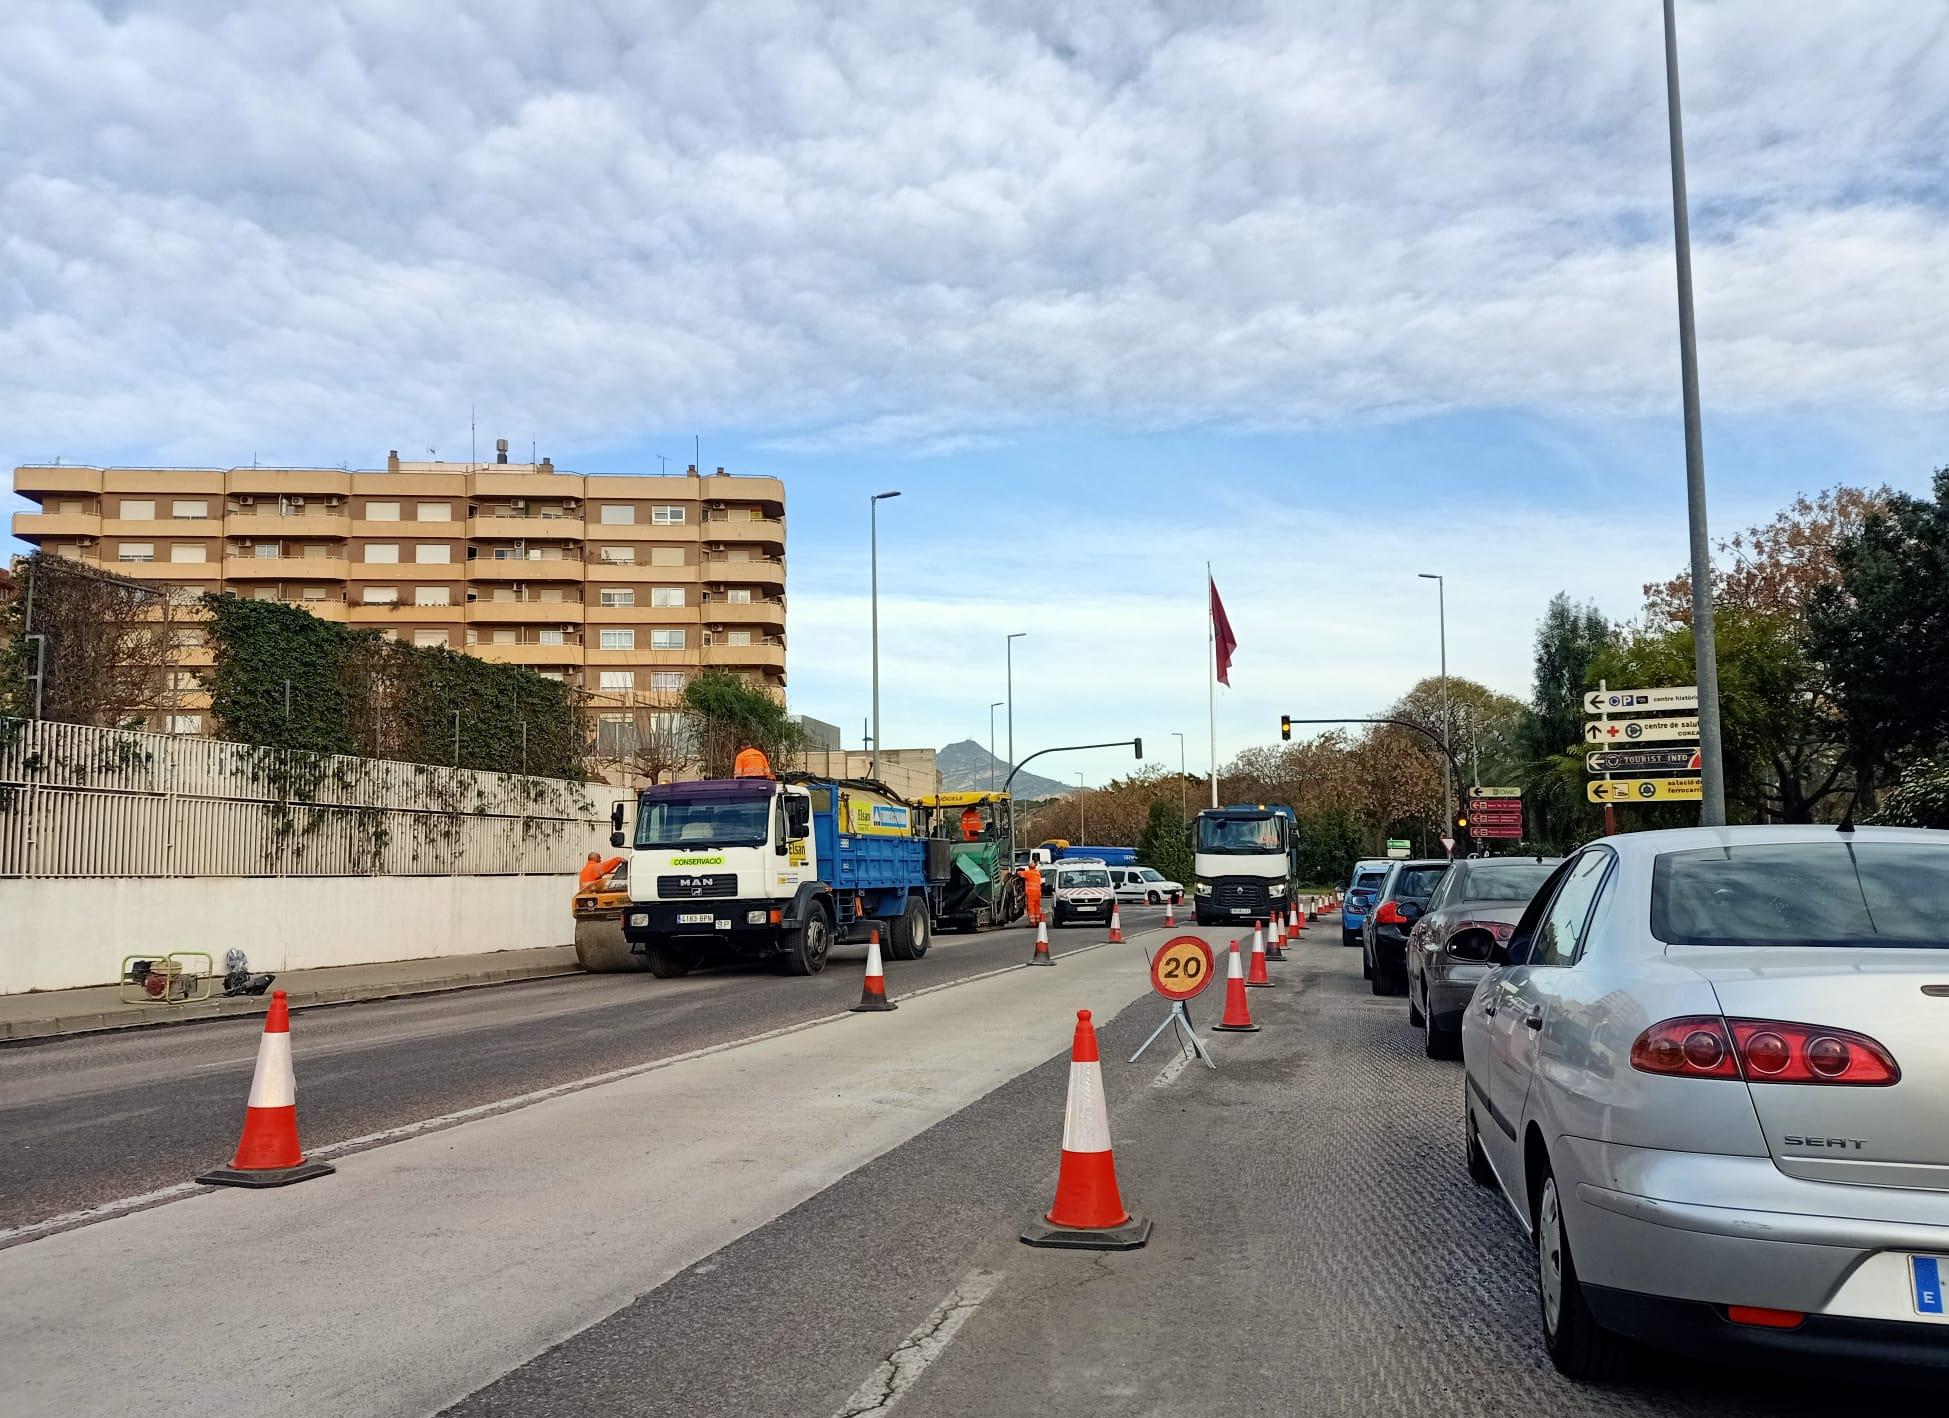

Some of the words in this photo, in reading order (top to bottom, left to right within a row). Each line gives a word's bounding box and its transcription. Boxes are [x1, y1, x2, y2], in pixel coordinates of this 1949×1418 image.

[1644, 722, 1668, 730] centre
[1623, 755, 1662, 763] TOURIST
[1667, 754, 1688, 762] INFO
[857, 809, 871, 822] Elsan
[788, 842, 806, 855] Elsan
[680, 878, 713, 887] MAN
[716, 920, 730, 928] SP
[1163, 956, 1201, 979] 20
[1784, 1135, 1869, 1150] SEAT
[1924, 1291, 1936, 1304] E
